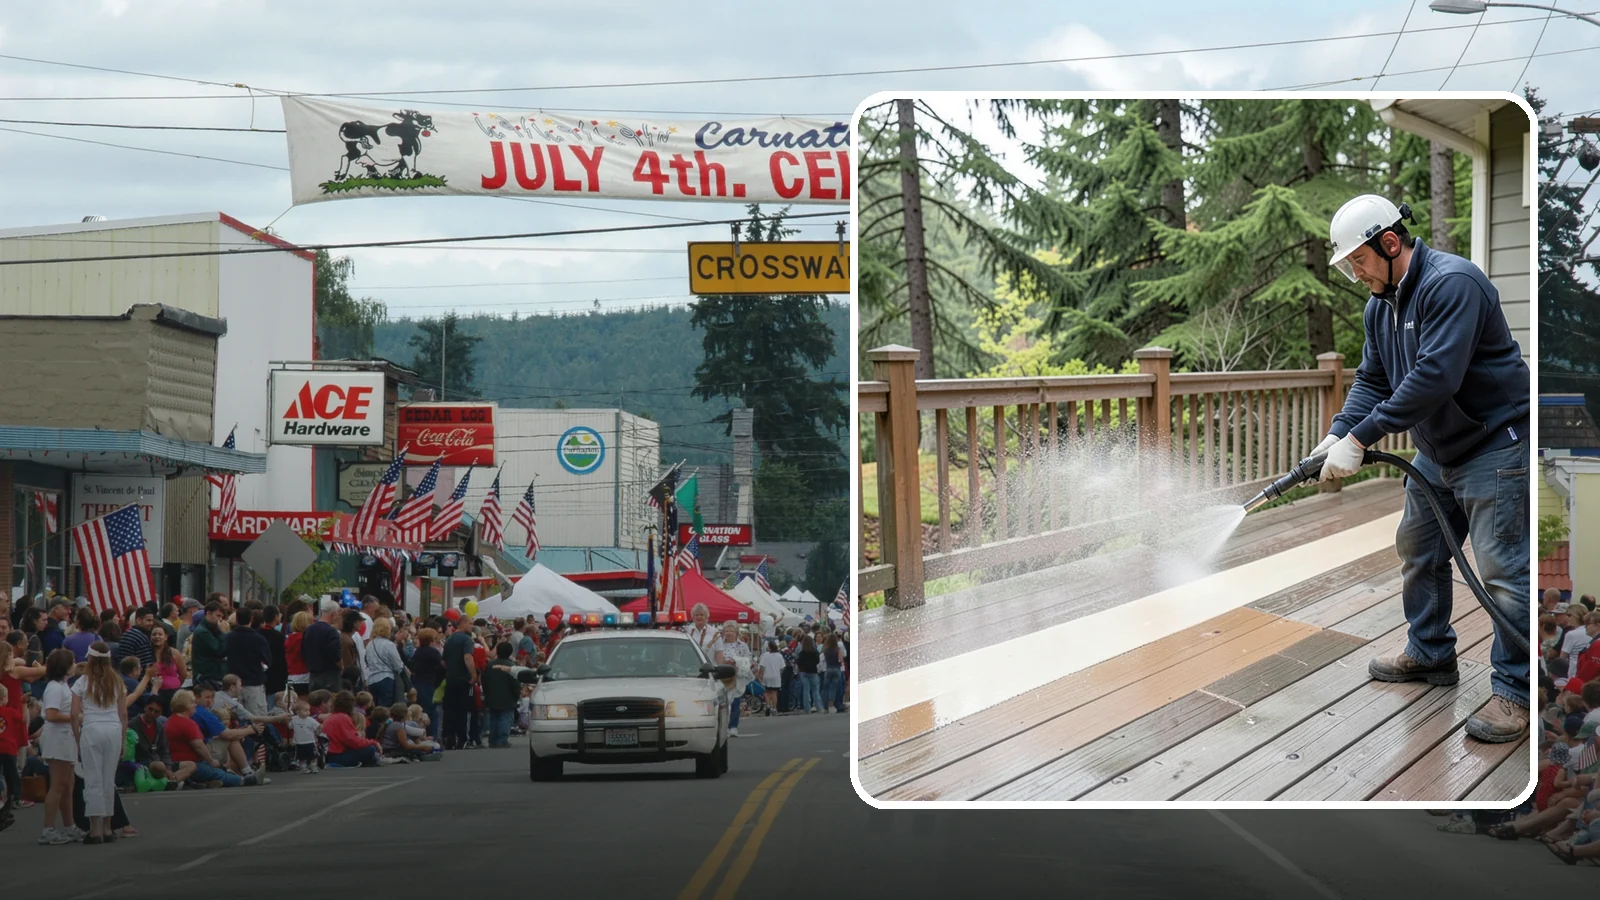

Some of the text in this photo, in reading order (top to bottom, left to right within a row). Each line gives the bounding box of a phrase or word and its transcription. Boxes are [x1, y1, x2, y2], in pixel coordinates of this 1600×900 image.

[481, 141, 605, 192] JULY
[633, 150, 746, 198] 4th.
[697, 254, 850, 280] CROSSWA
[283, 380, 373, 420] ACE
[405, 409, 453, 422] CEDAR
[283, 421, 370, 436] Hardware
[416, 428, 477, 447] Coca-Cola
[353, 467, 386, 480] Simpl
[83, 485, 155, 495] St. Vincent de Paul
[688, 526, 741, 535] CRNATION
[699, 535, 730, 543] GLASS
